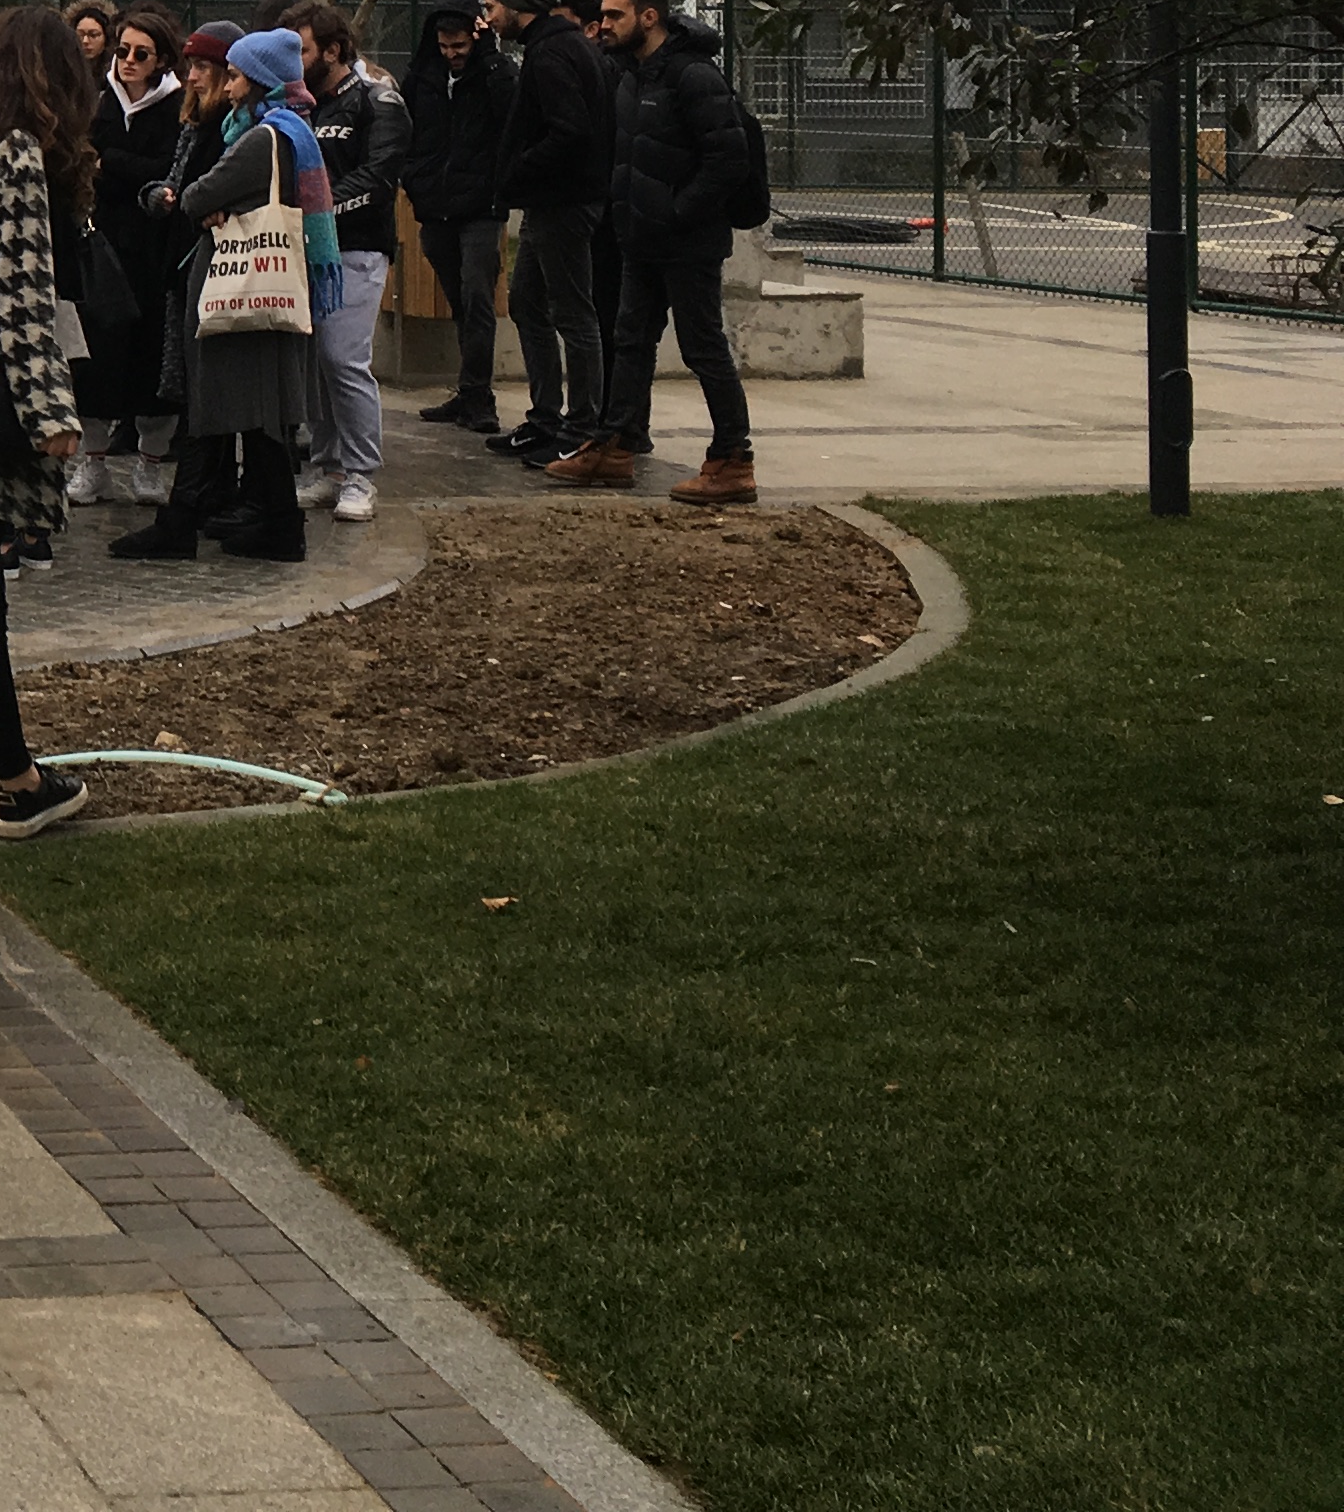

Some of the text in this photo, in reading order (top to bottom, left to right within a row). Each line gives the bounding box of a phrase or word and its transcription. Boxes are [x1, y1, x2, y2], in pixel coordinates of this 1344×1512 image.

[217, 232, 291, 254] ORTOBELLO
[208, 256, 287, 278] ROAD W11
[205, 297, 295, 312] CITY OF LONDON
